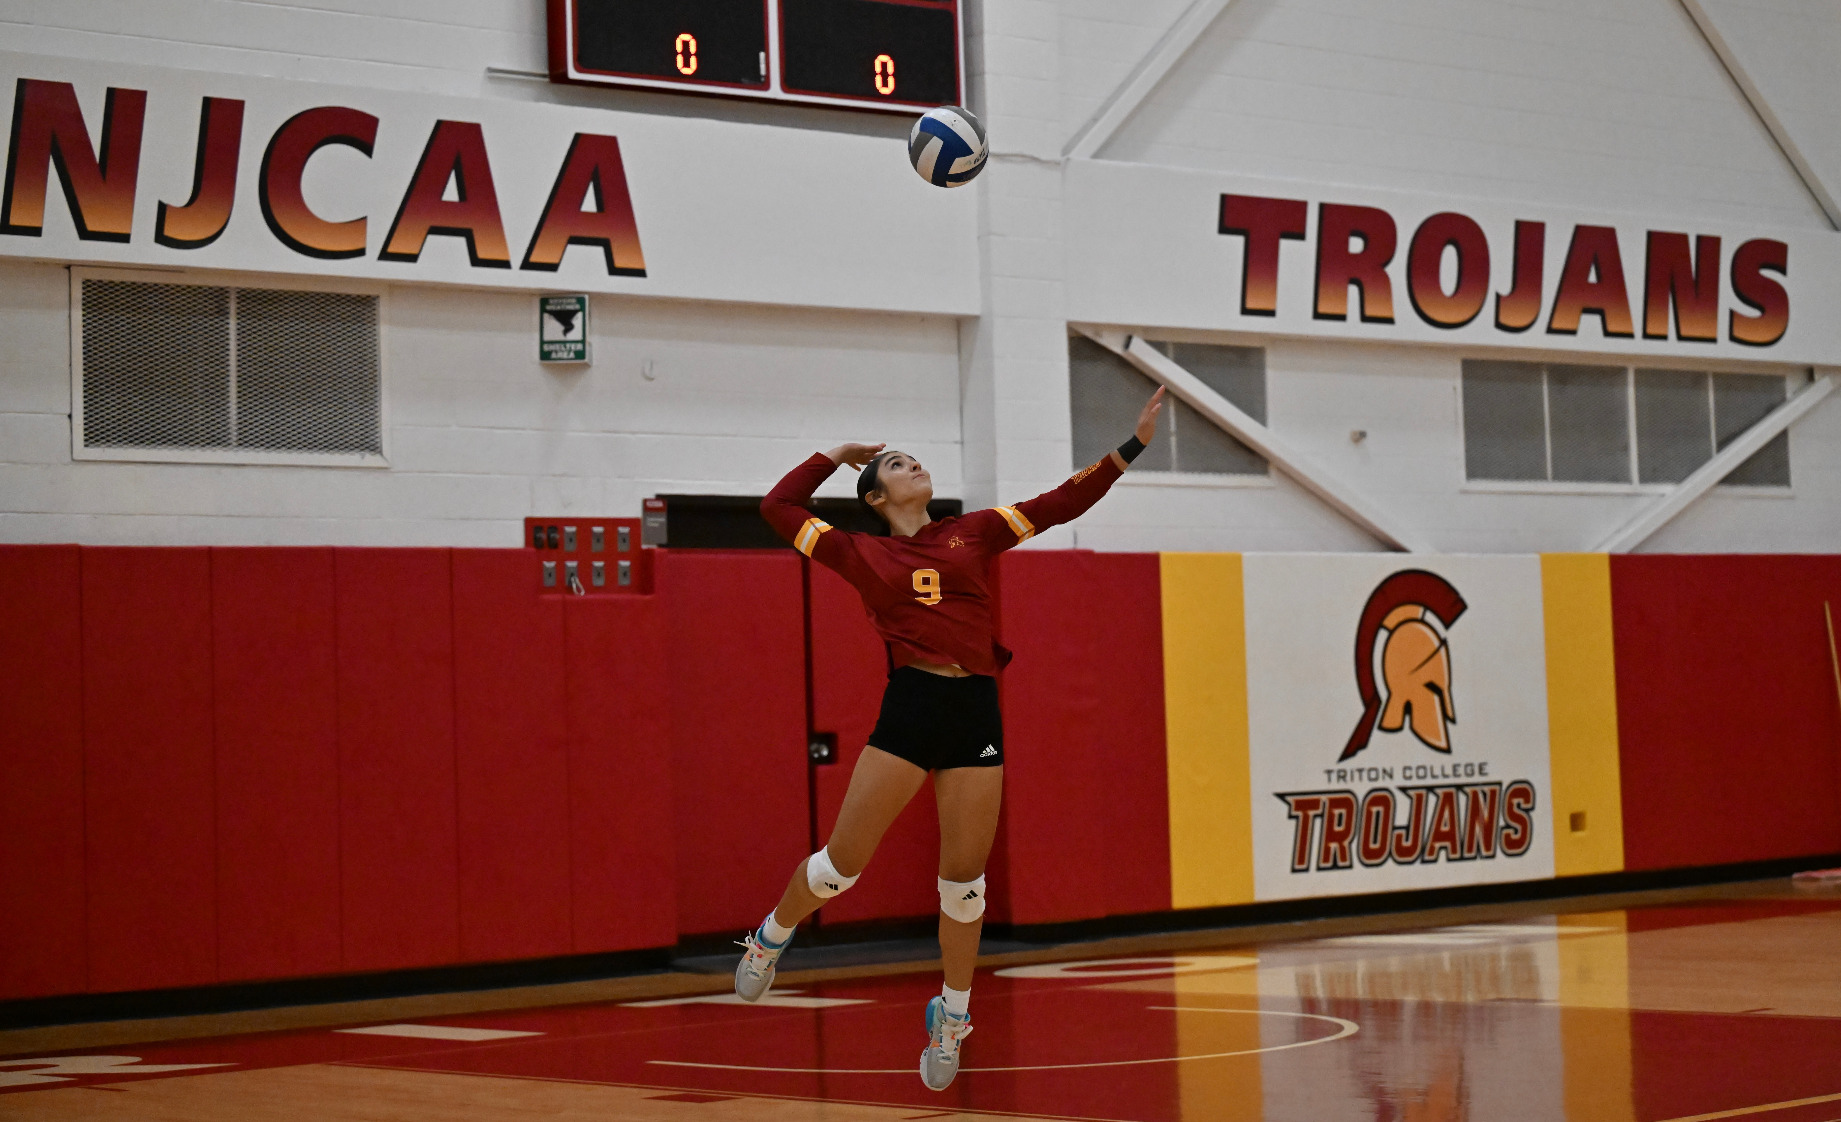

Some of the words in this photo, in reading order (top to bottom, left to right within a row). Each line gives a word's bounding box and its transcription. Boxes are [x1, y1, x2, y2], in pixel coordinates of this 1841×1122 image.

[675, 33, 698, 75] 0
[874, 54, 896, 95] 0
[0, 78, 648, 278] NJCAA
[1218, 193, 1790, 347] TROJANS
[543, 343, 584, 351] SHELTER
[550, 351, 576, 359] AREA
[912, 568, 943, 606] 9
[1324, 767, 1394, 783] TRITON
[1403, 762, 1489, 780] COLLEGE
[1273, 780, 1536, 874] TROJANS
